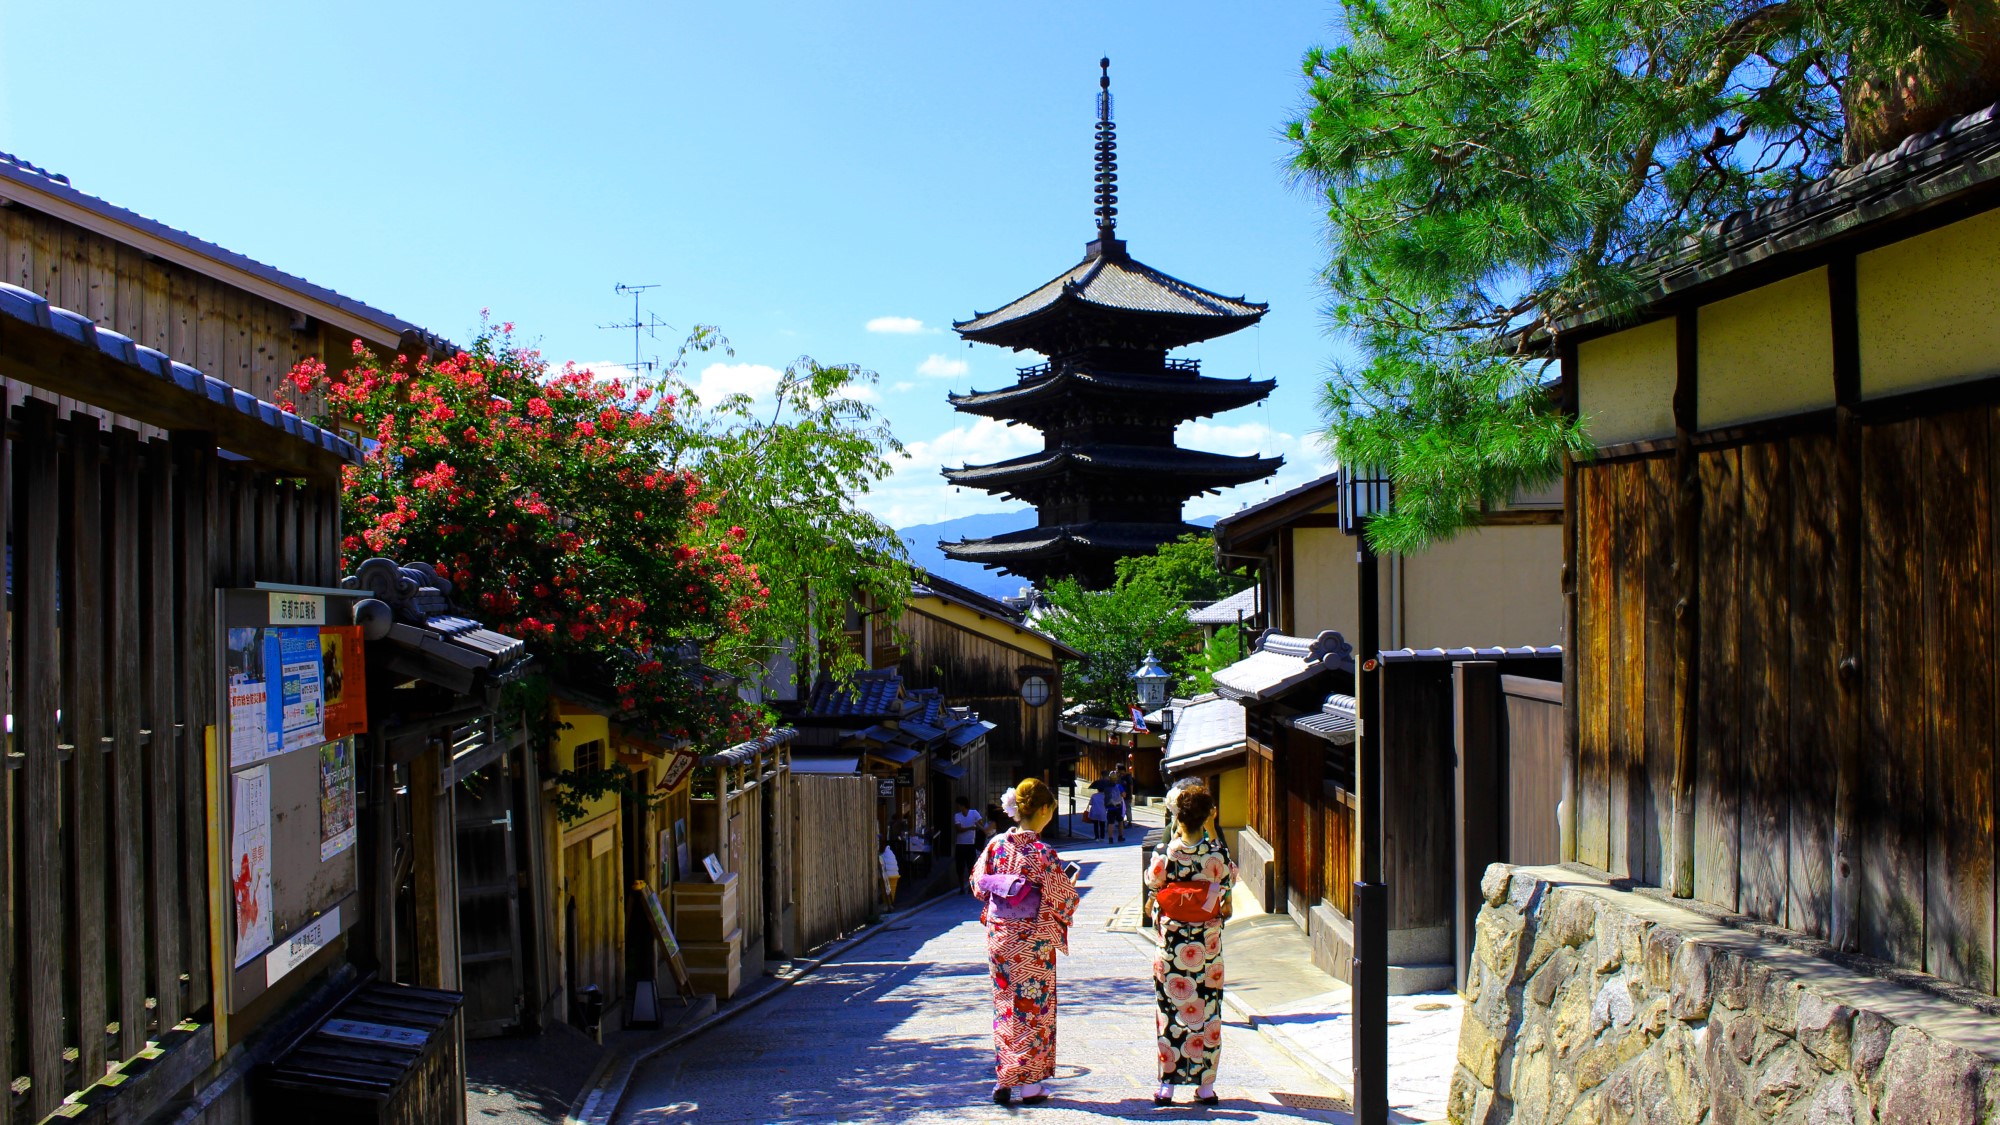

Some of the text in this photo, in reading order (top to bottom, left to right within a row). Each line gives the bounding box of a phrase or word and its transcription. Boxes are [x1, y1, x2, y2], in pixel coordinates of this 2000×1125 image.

[281, 599, 316, 620] 京都市広報板
